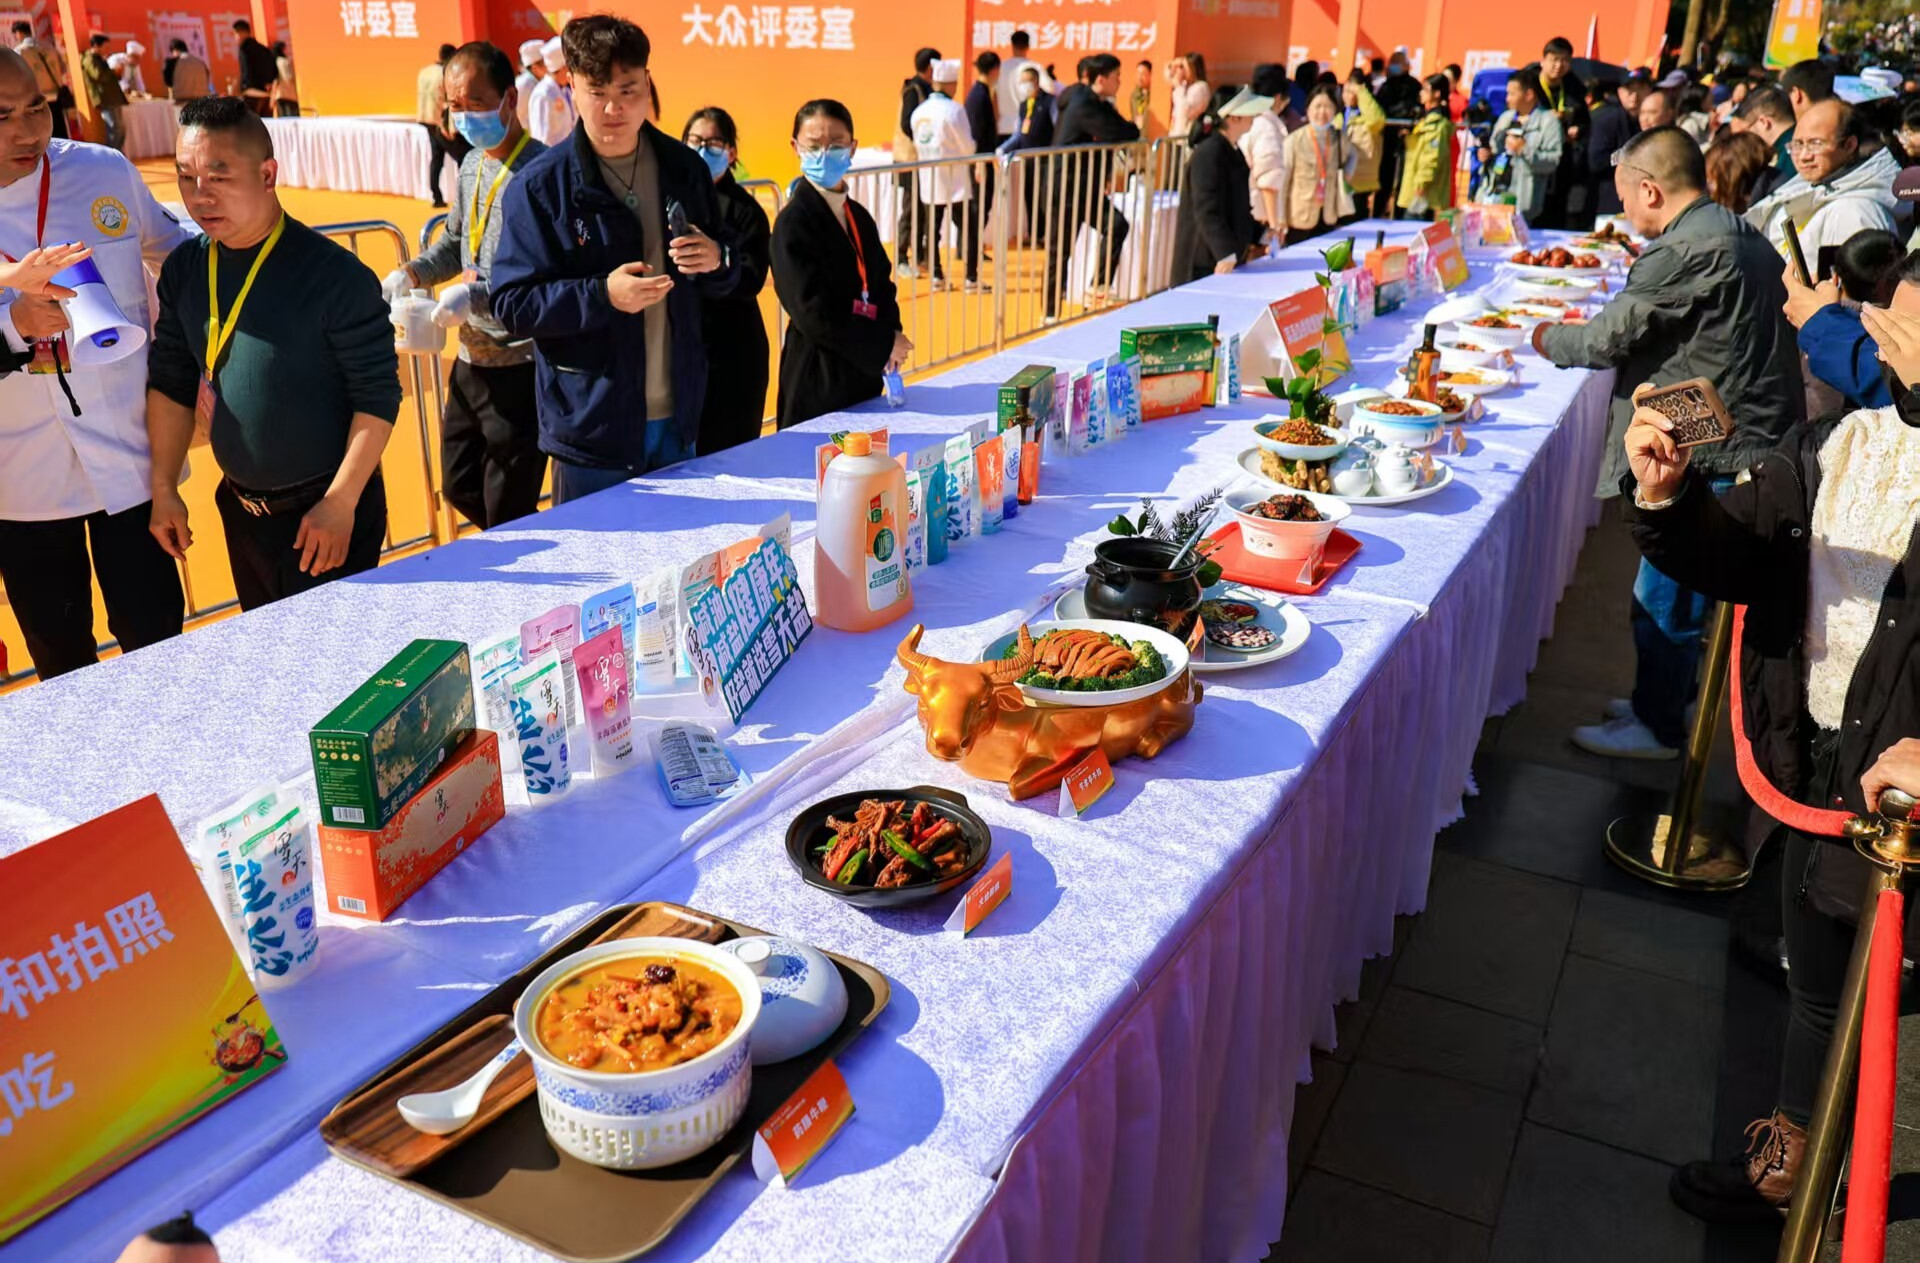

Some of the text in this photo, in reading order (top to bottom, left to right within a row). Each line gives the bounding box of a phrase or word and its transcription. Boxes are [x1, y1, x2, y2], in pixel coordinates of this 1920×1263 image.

[340, 0, 420, 39] 评委室
[682, 4, 856, 51] 大众评委室
[727, 541, 787, 641] 健康年
[713, 617, 746, 678] 减盐
[724, 585, 813, 719] 好盐就选雪天盐
[274, 831, 307, 879] 雪天
[0, 891, 175, 1019] 和拍照
[234, 857, 295, 977] 生态
[0, 1050, 76, 1137] 吃
